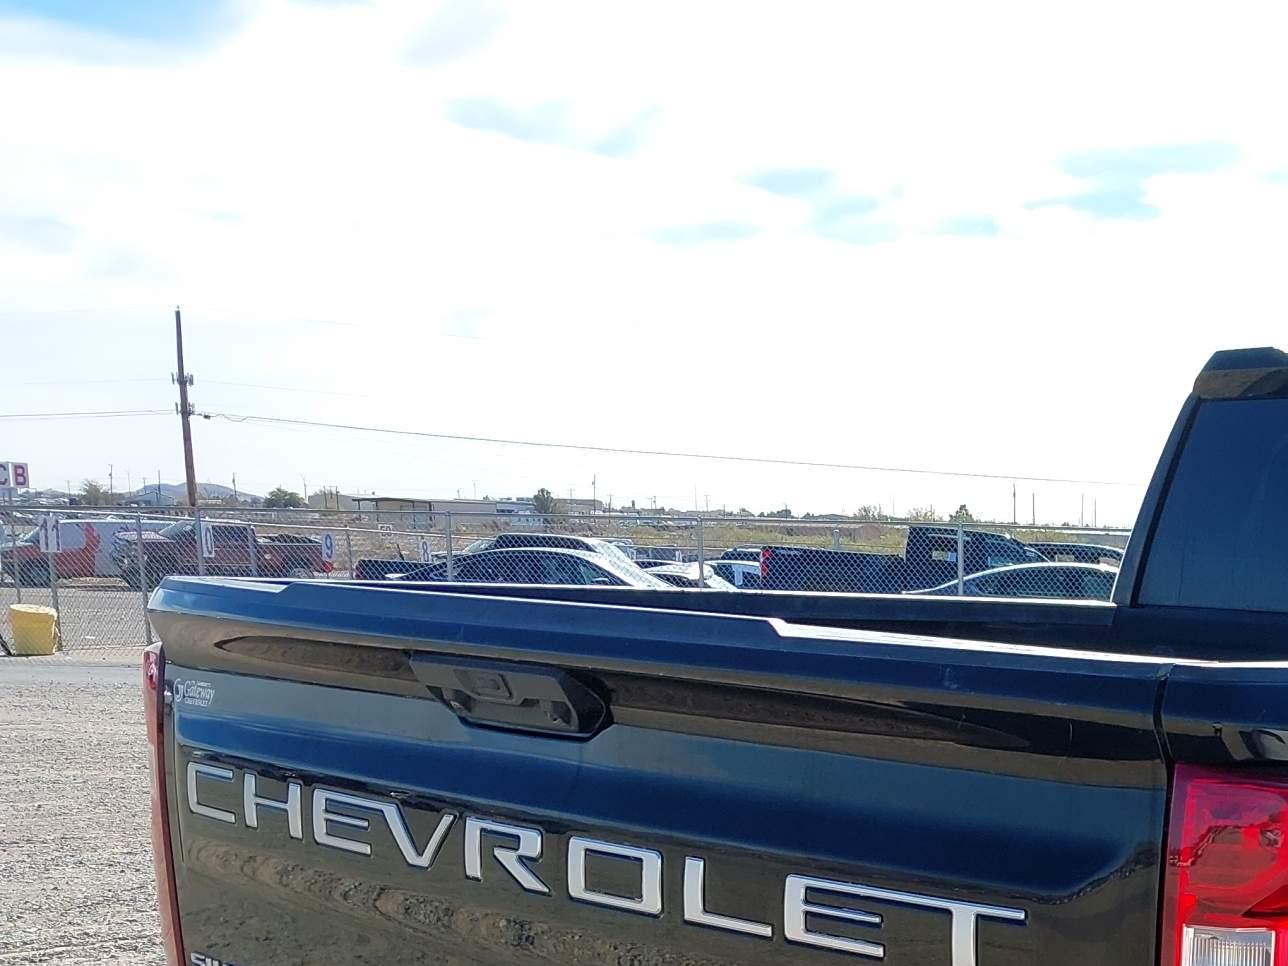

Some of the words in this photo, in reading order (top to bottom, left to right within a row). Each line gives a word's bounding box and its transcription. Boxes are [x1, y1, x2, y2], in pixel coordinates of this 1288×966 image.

[14, 465, 26, 486] B
[325, 533, 333, 559] 9
[184, 680, 215, 704] Gateway
